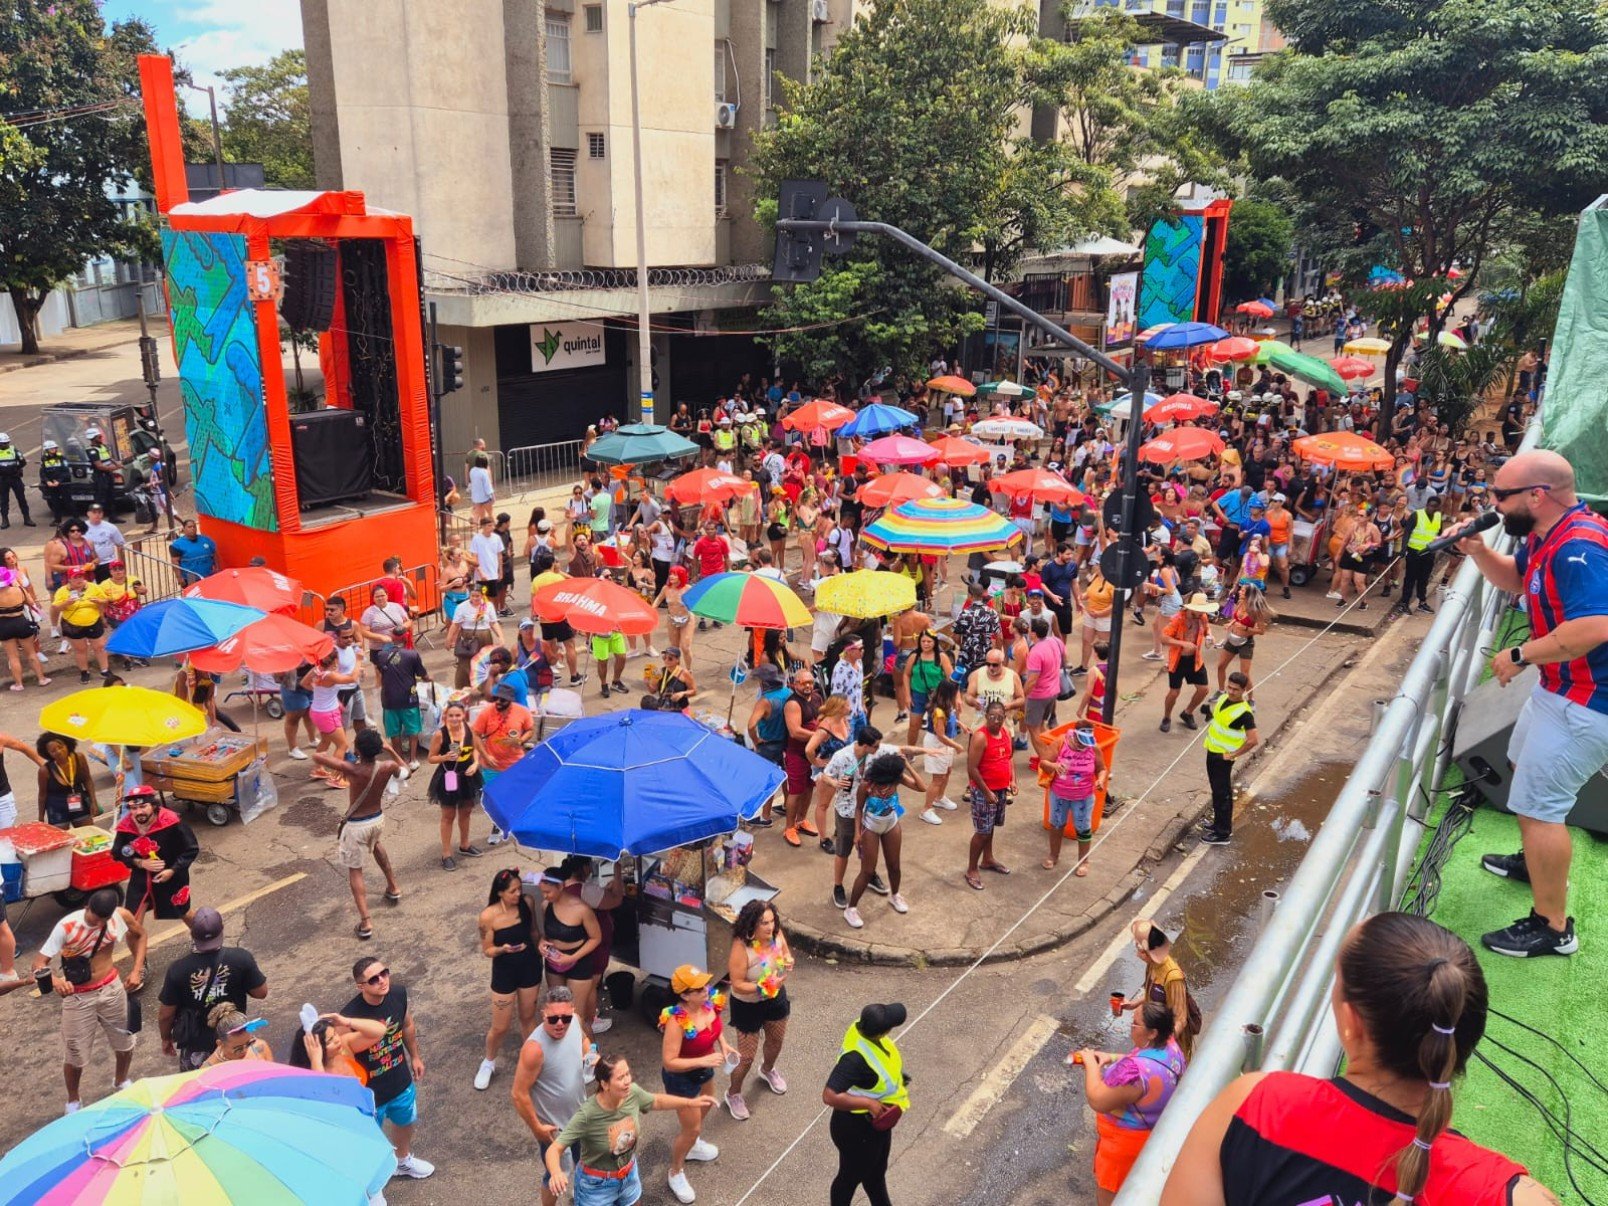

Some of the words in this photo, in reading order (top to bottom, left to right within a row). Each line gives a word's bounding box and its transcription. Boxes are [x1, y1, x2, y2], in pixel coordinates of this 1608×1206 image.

[256, 265, 271, 293] 5
[563, 334, 601, 355] quintal
[553, 591, 608, 617] BRAHMA
